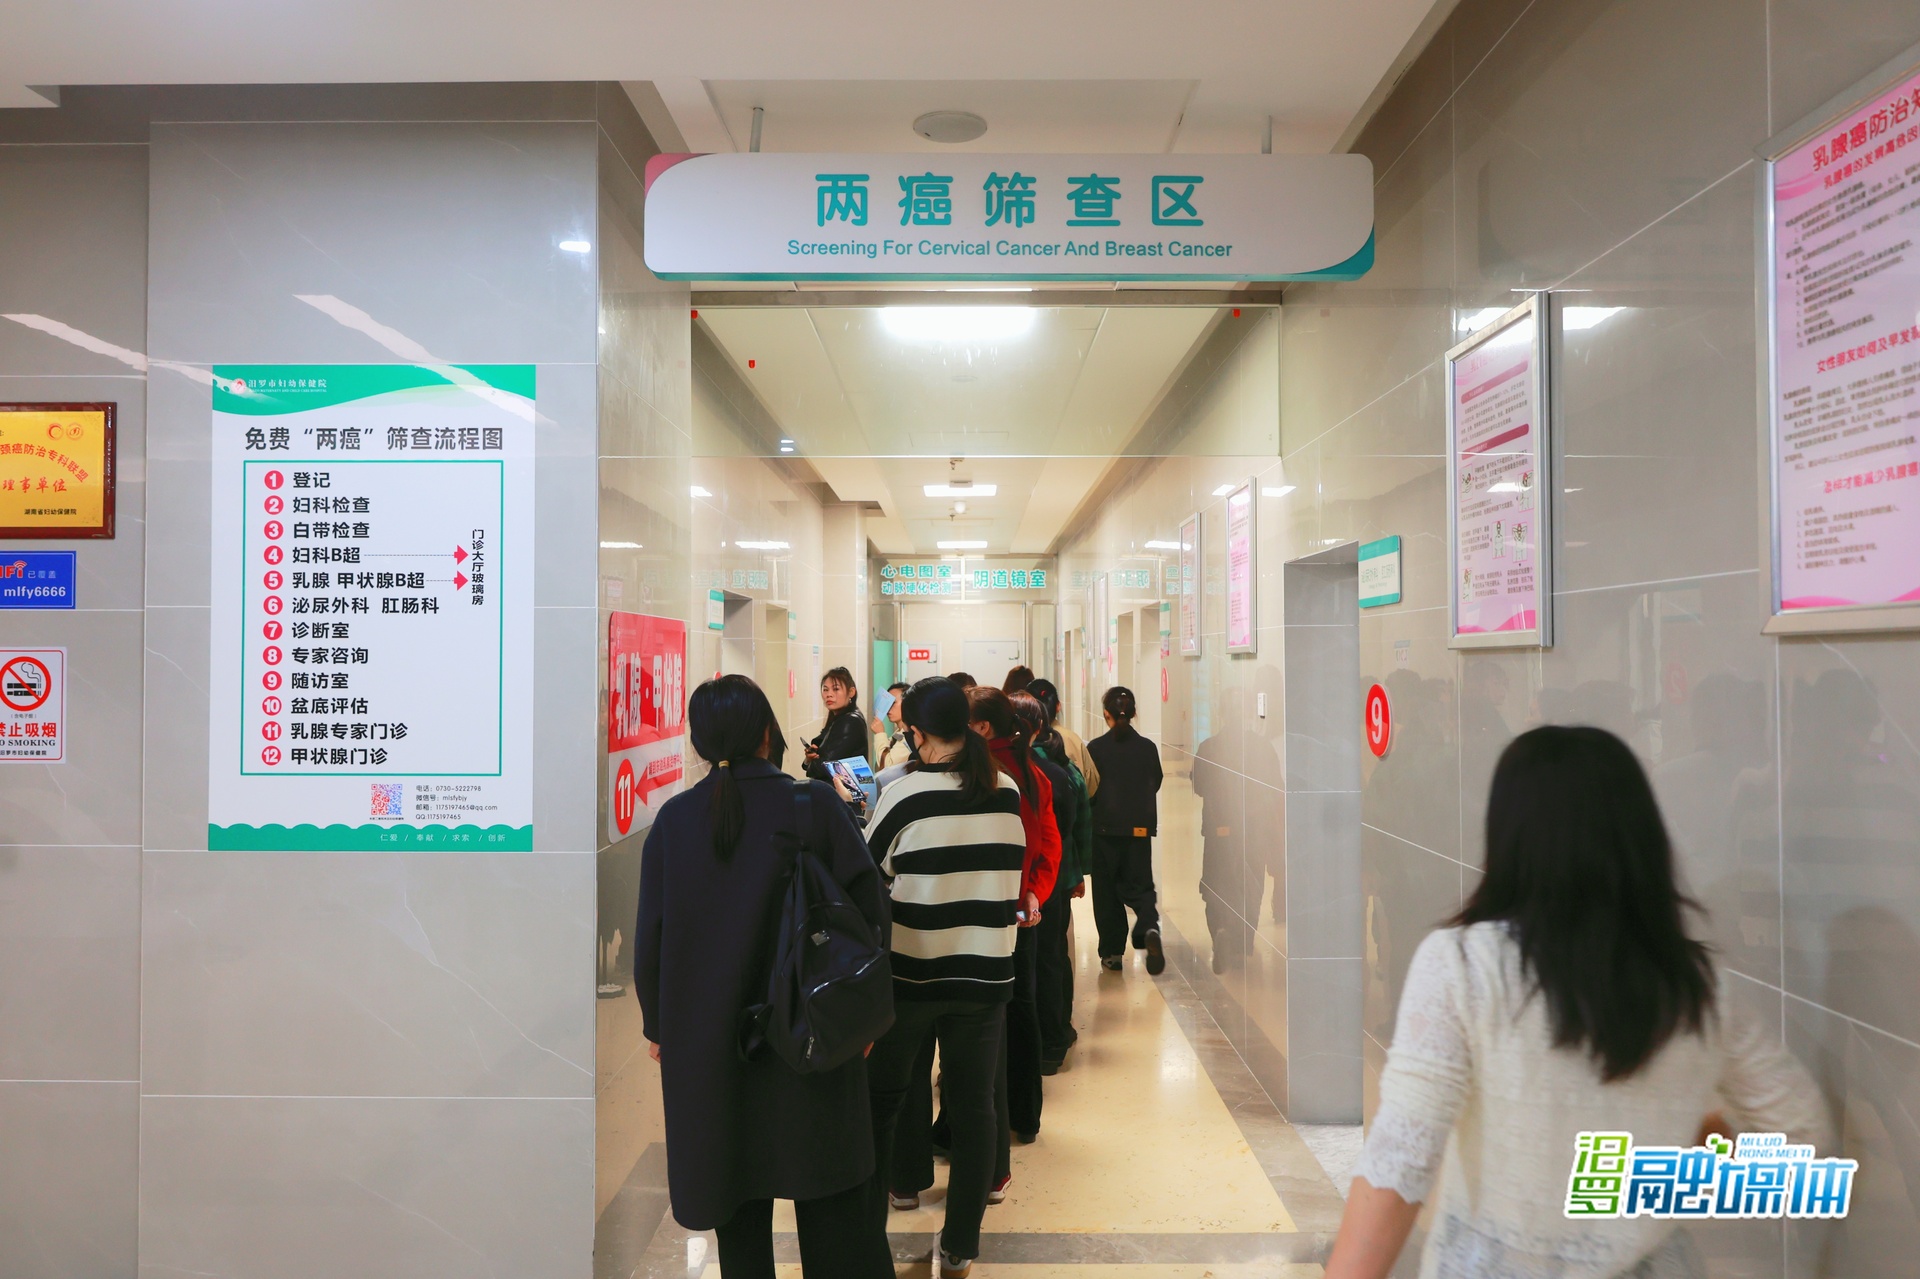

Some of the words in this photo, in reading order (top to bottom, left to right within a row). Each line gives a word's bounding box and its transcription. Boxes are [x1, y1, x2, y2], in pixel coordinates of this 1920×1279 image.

[816, 172, 1204, 229] 两癌筛查区
[787, 239, 877, 259] Screening
[883, 239, 914, 256] For
[918, 239, 990, 257] Cervical
[996, 240, 1062, 257] Cancer
[1064, 240, 1100, 257] And
[1105, 240, 1164, 257] Breast
[1168, 240, 1233, 257] Cancer
[293, 471, 331, 489] 登记
[293, 496, 370, 514] 妇科检查
[293, 521, 370, 539] 白带检查
[293, 547, 361, 564] 妇科B超
[471, 528, 485, 606] 门诊大厅玻璃房
[882, 564, 952, 579] 心电图室
[973, 569, 1047, 589] 阴道镜室
[4, 586, 67, 600] mlfy6666
[292, 622, 350, 639] 诊断室
[292, 647, 369, 665] 专家咨询
[291, 672, 349, 690] 随访室
[290, 697, 369, 715] 盆底评估
[1371, 697, 1383, 744] 9
[290, 722, 408, 740] 乳腺专家门诊
[8, 739, 56, 747] SMOKING
[291, 748, 388, 765] 甲状腺门诊
[617, 773, 631, 820] 11
